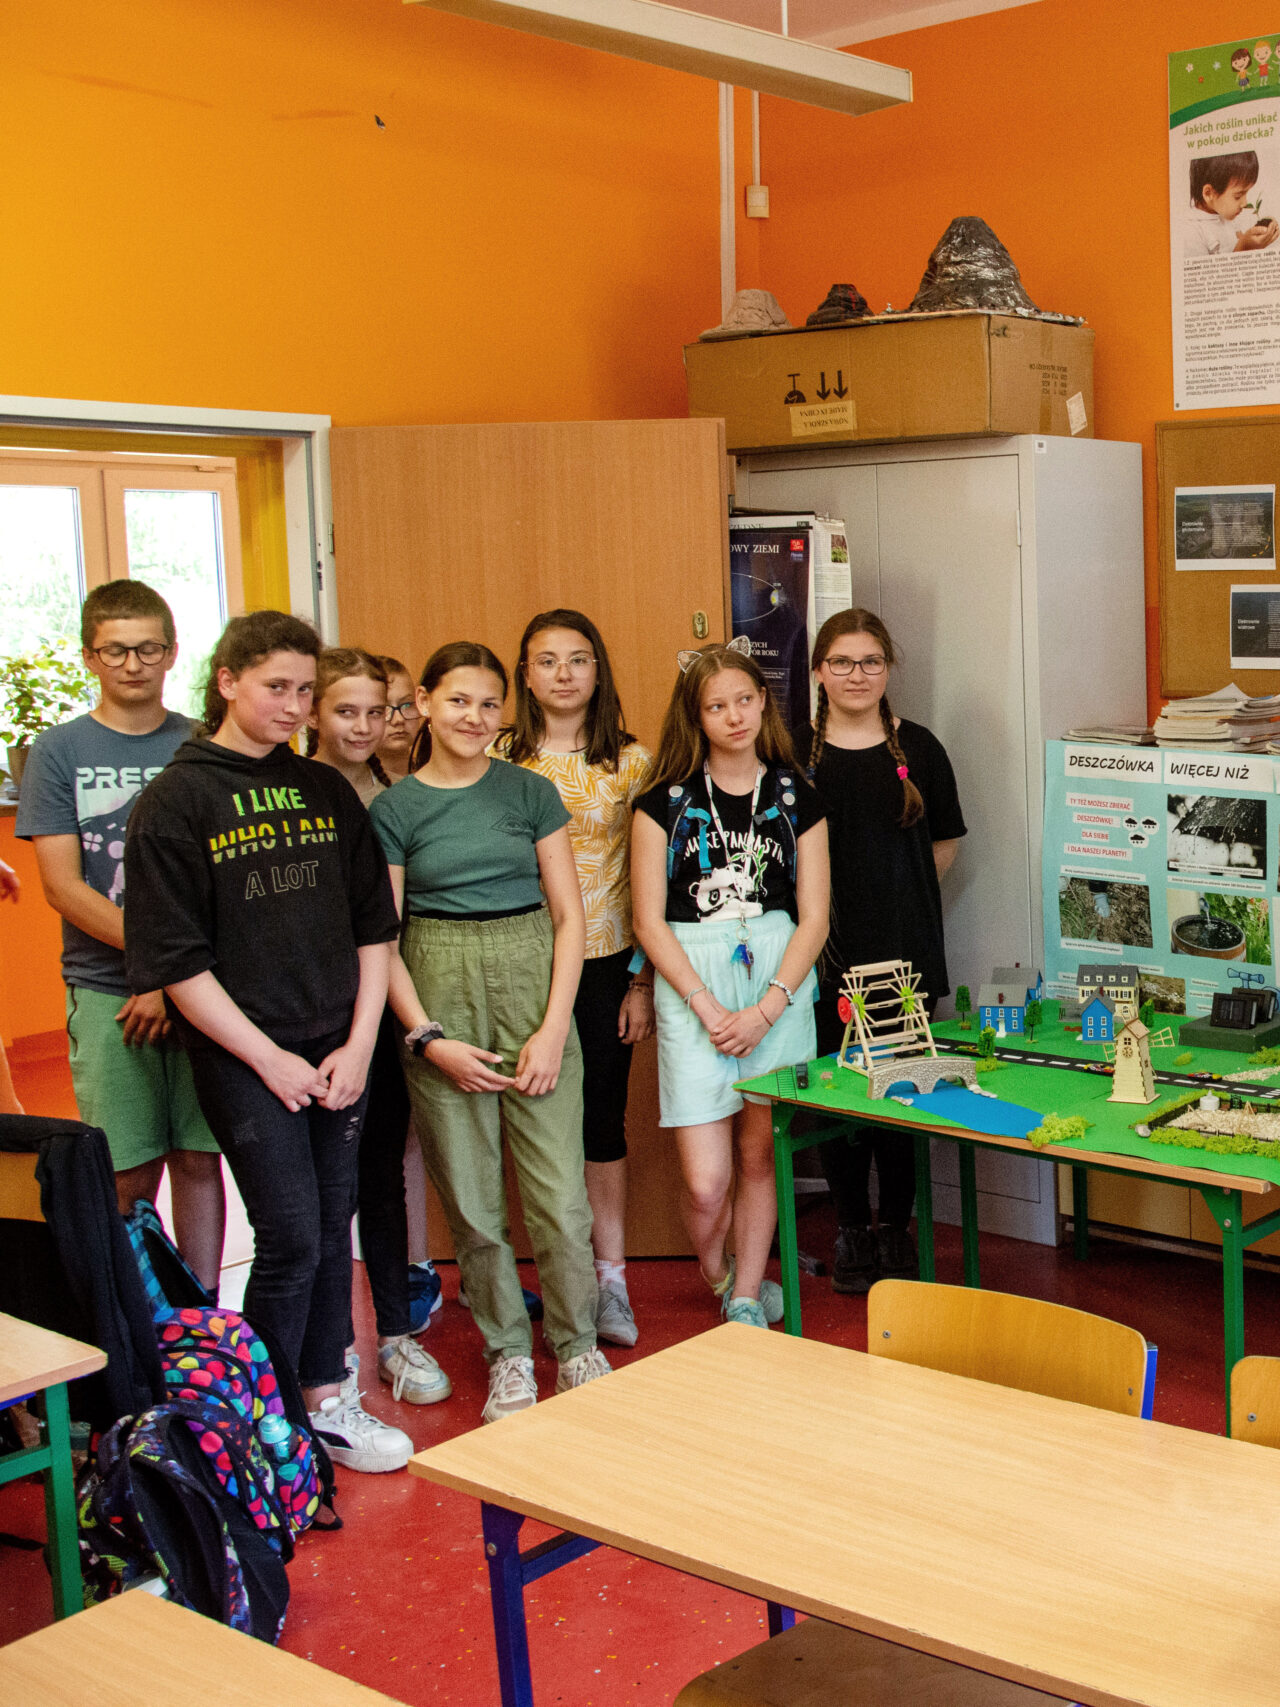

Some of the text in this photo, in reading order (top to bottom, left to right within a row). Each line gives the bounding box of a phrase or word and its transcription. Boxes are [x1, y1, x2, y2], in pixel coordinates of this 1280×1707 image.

[1183, 112, 1279, 136] Jakich roślin unikać
[1187, 127, 1275, 150] w pokoju dziecka?
[753, 544, 780, 553] ZIEMI
[761, 649, 779, 657] ROKU
[1069, 754, 1155, 774] DESZCZÓWKA
[1170, 762, 1250, 780] WIĘCEJ NIŻ
[232, 786, 306, 817] I LIKE
[1078, 798, 1087, 806] TEŻ
[1088, 800, 1109, 808] MOŻESZ
[1109, 801, 1131, 810] ZBIERAĆ
[208, 815, 339, 864] WHO I AM
[1093, 832, 1109, 840] SIEBIE
[1071, 845, 1081, 853] DLA
[1082, 847, 1102, 855] NASZEJ
[245, 860, 319, 900] A LOT
